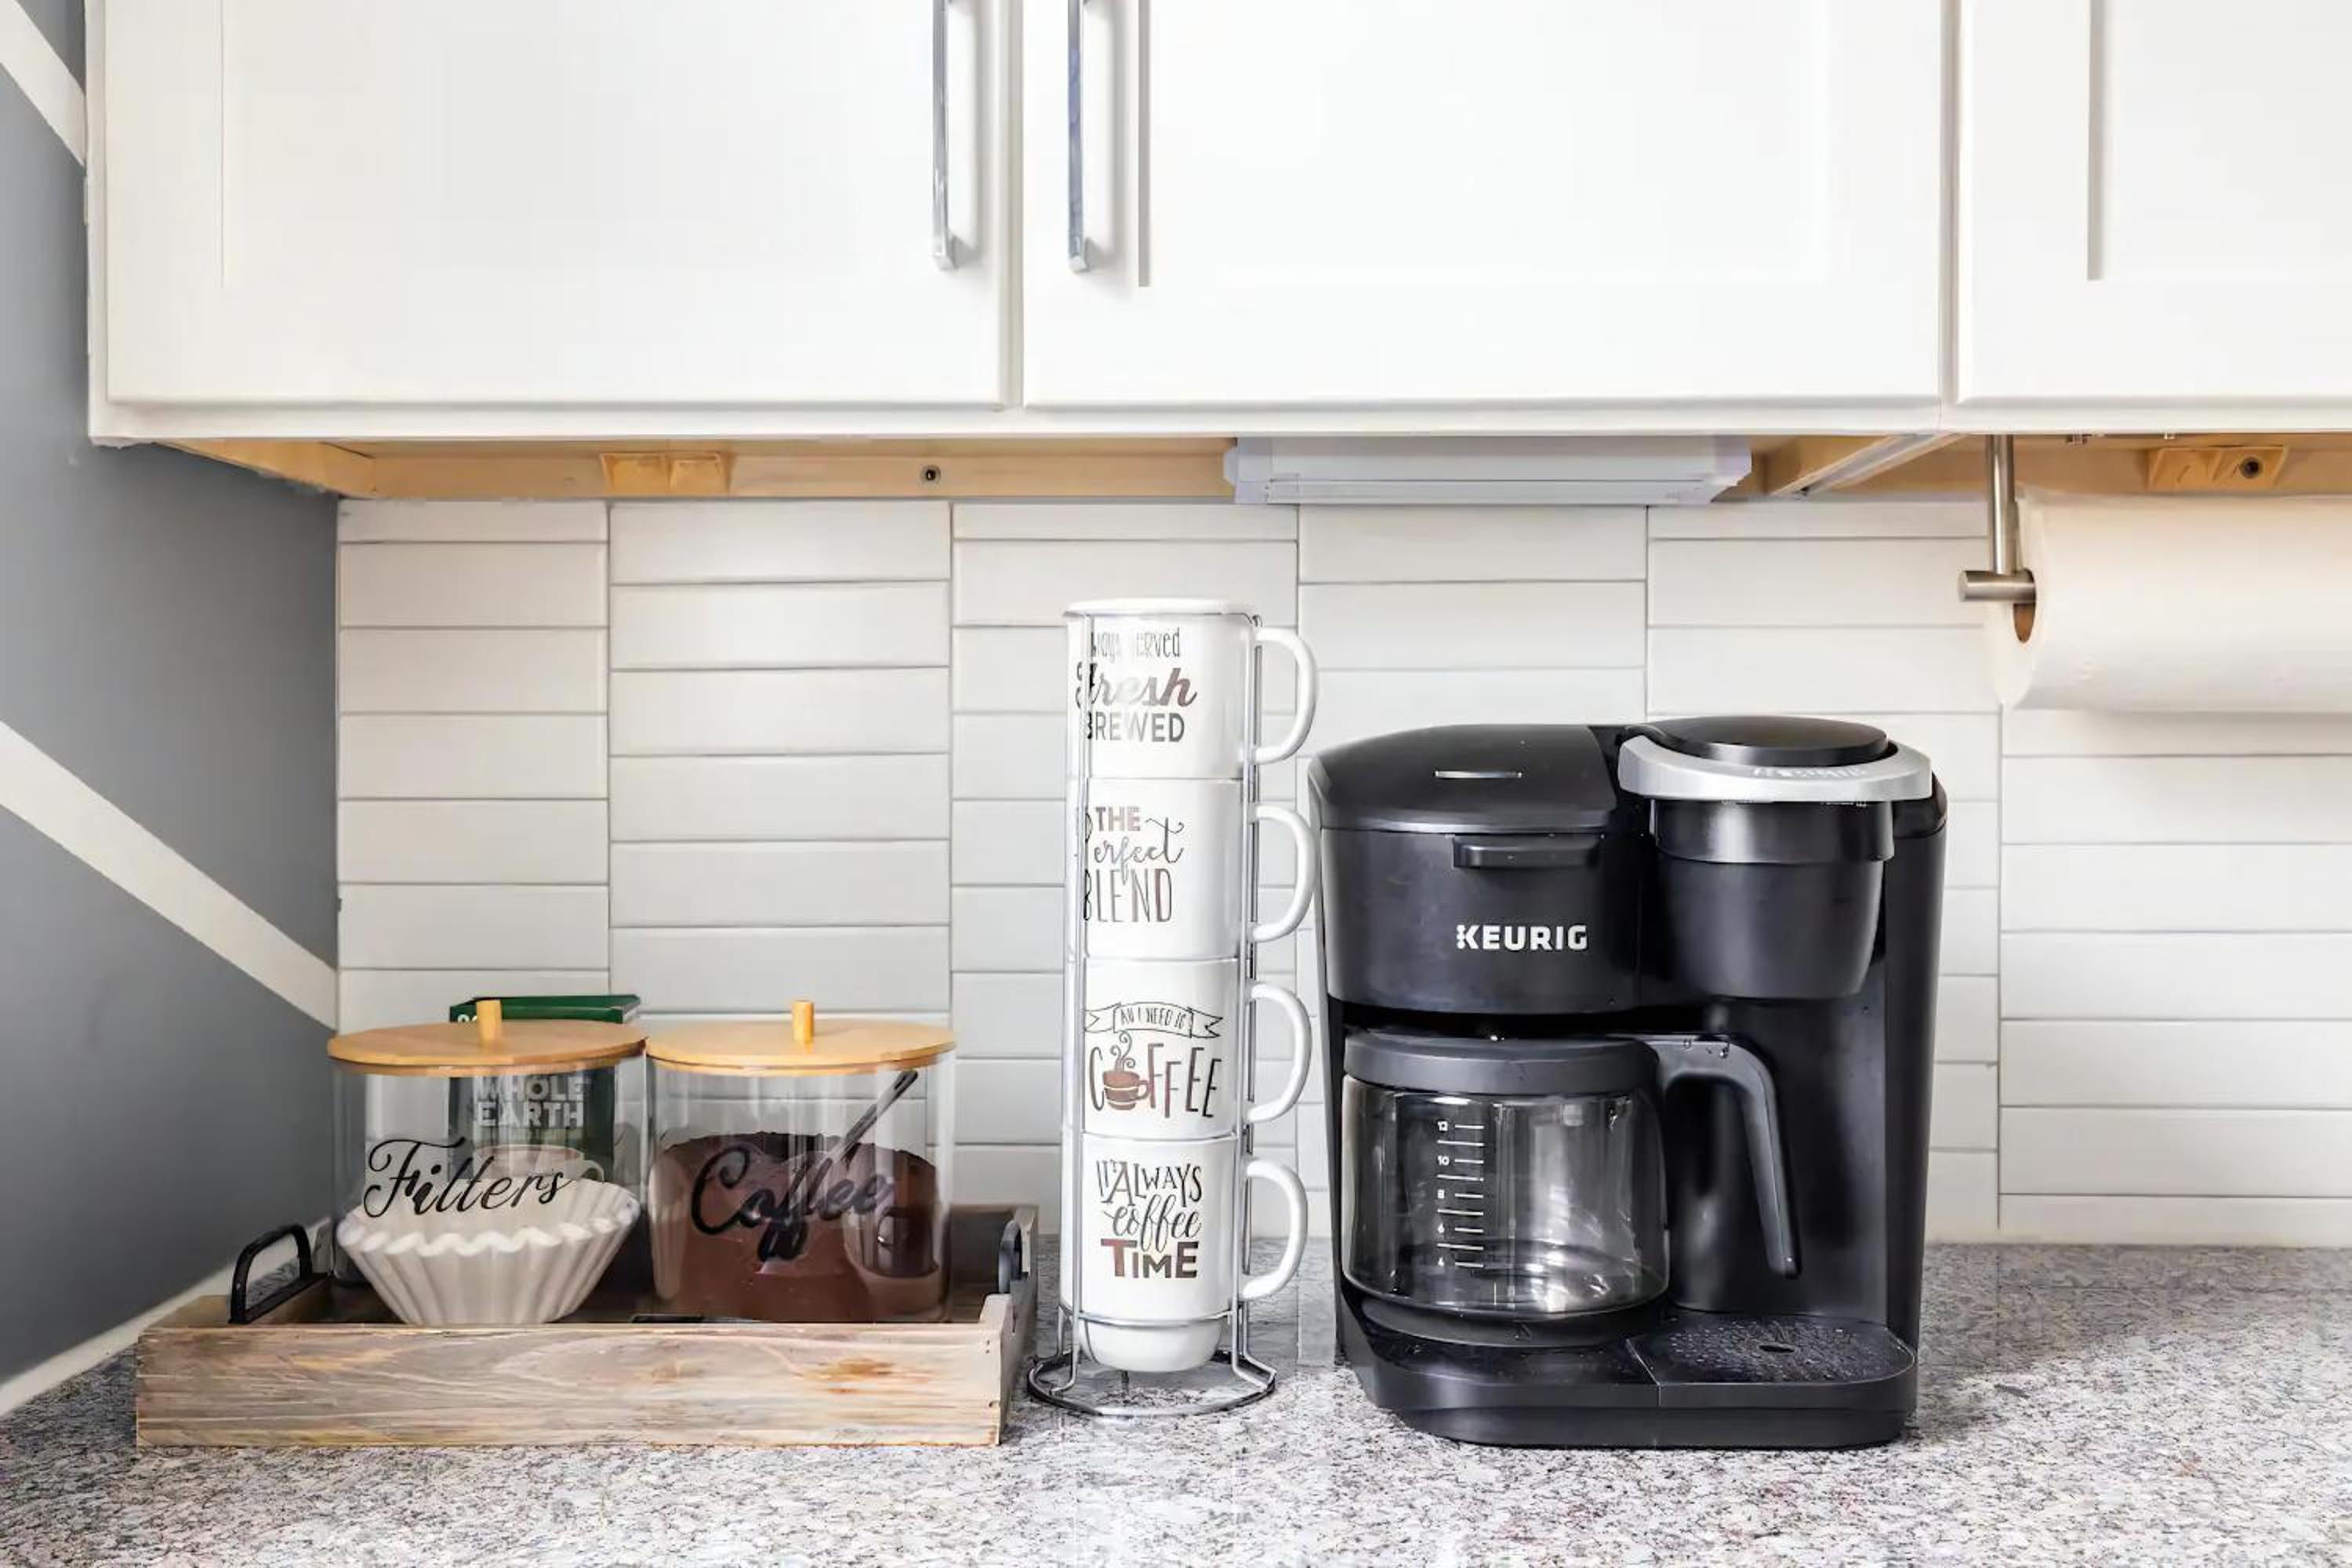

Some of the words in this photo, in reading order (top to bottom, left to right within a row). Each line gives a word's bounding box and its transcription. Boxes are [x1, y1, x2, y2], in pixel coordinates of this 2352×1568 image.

[1095, 806, 1142, 832] THE
[1456, 924, 1588, 951] KEURIG
[1145, 1007, 1174, 1026] NEED
[473, 1075, 584, 1102] WHOLE
[477, 1101, 584, 1127] EARTH
[1437, 1155, 1450, 1166] 10
[363, 1137, 575, 1218] Filters
[691, 1145, 895, 1261] Coffee
[1103, 1194, 1203, 1253] coffee
[1100, 1237, 1200, 1279] TIME
